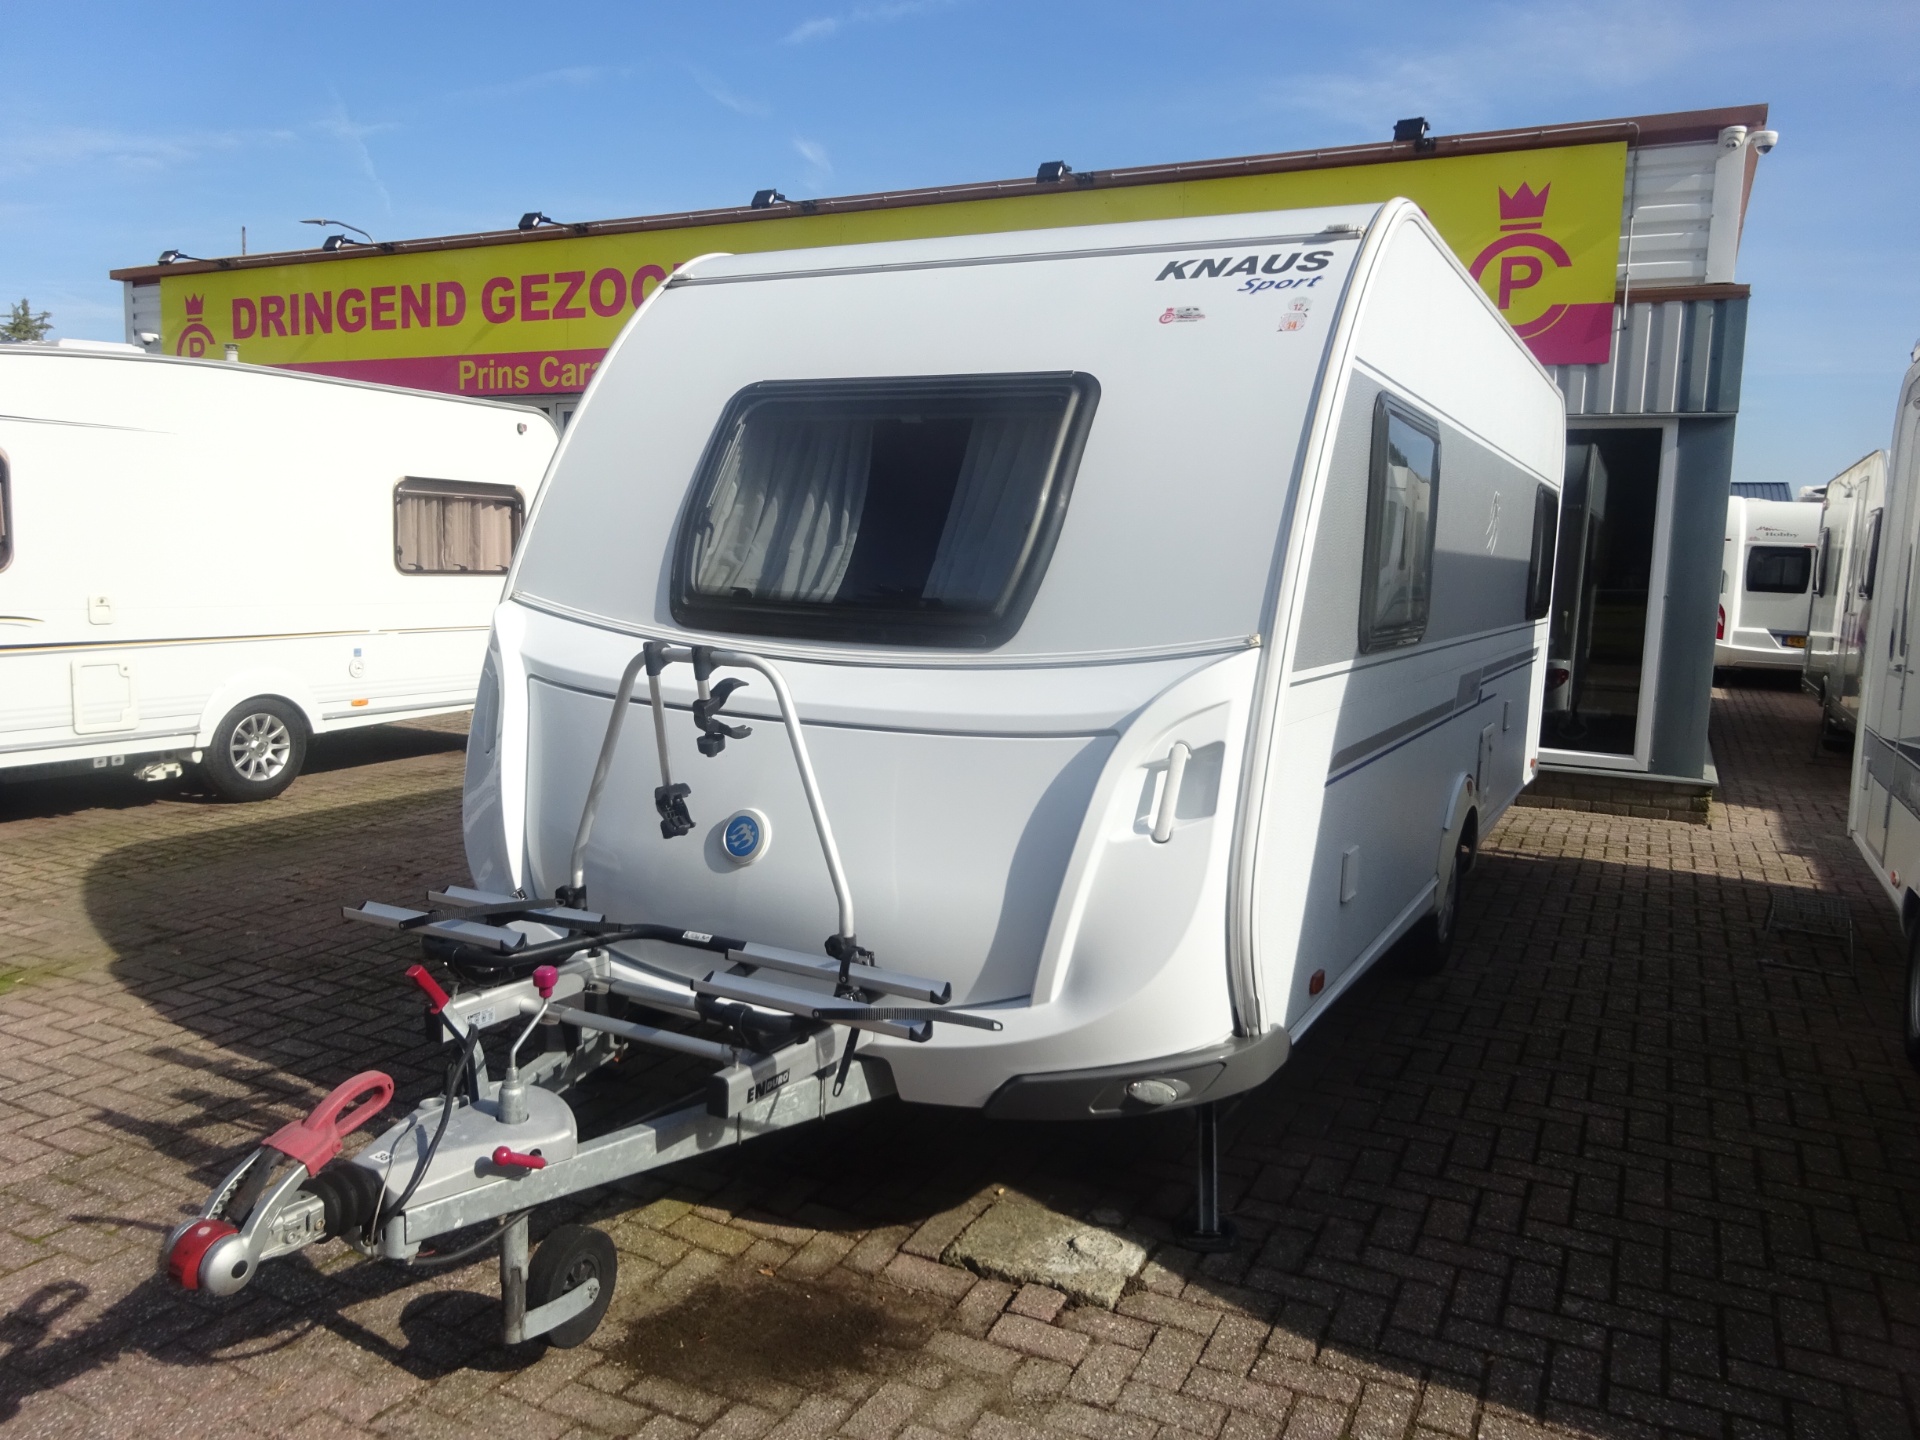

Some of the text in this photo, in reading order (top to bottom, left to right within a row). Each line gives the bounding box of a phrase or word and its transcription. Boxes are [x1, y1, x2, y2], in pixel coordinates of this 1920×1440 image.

[1155, 251, 1334, 281] KNAUS
[1237, 275, 1324, 294] Sport
[232, 263, 685, 339] DRINGEND GEZOC
[459, 360, 529, 390] Prins
